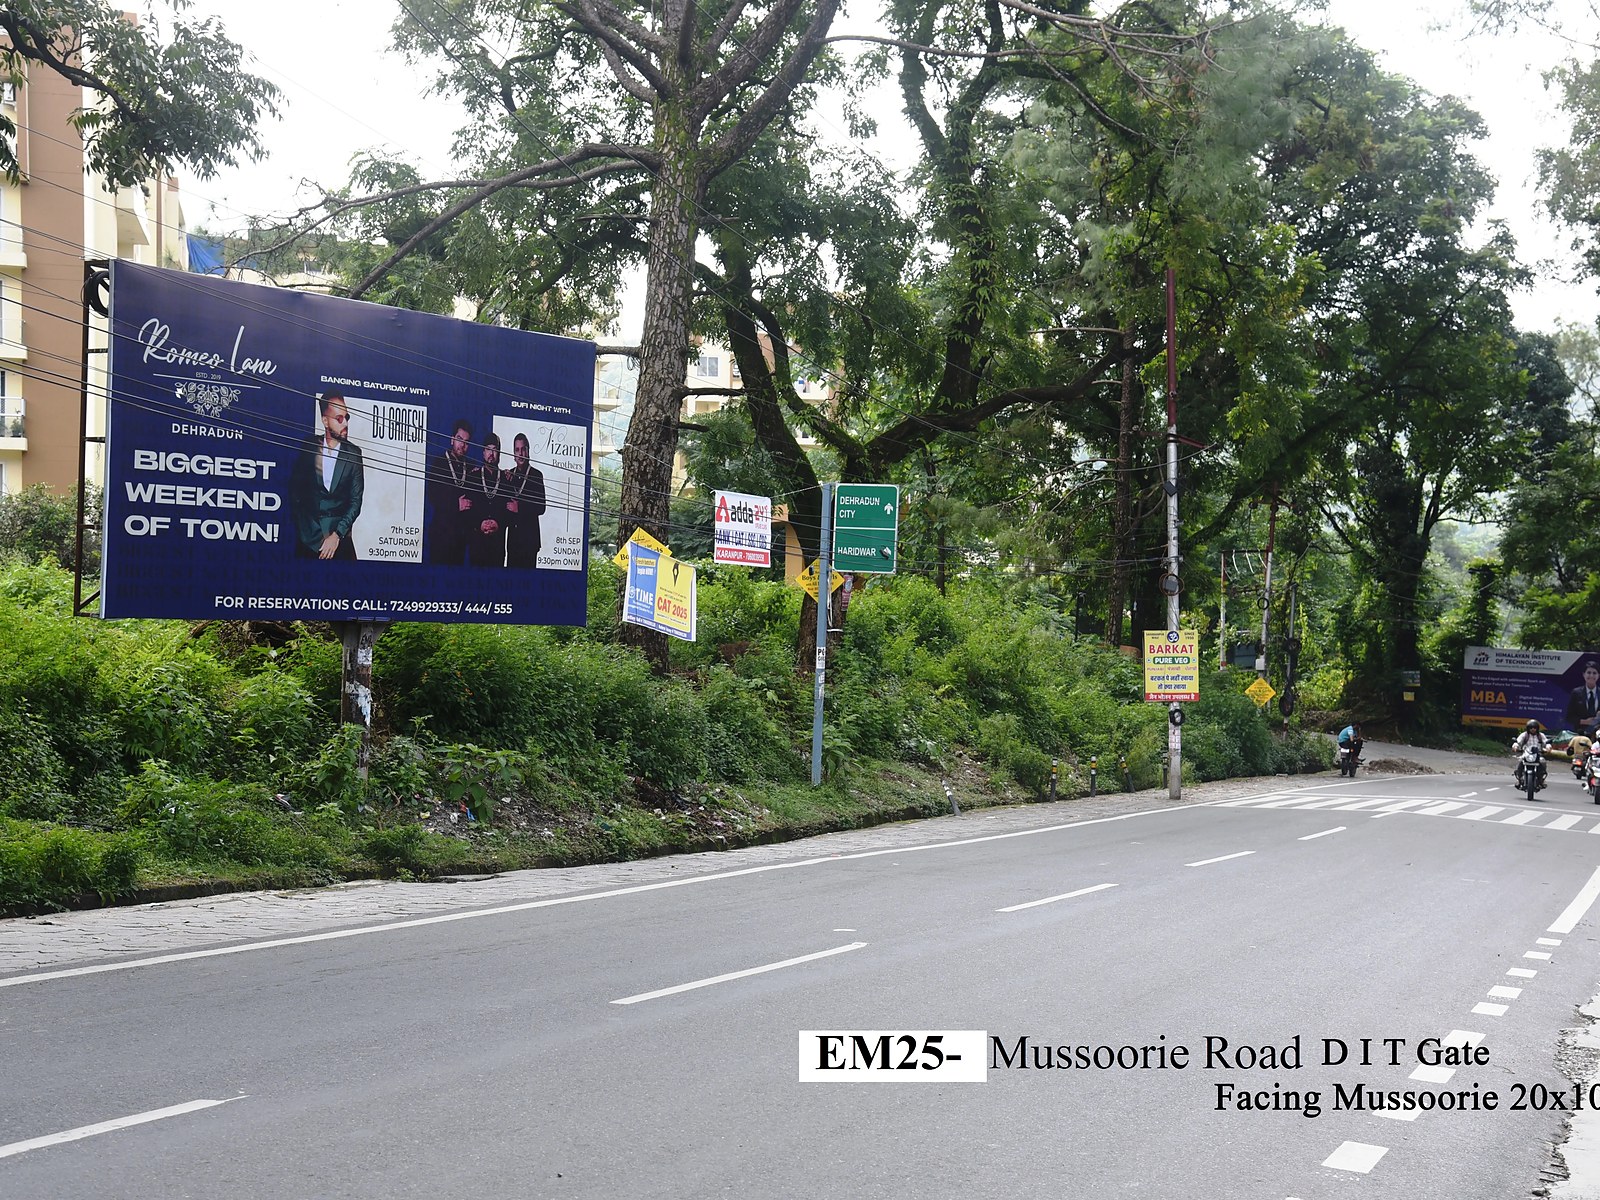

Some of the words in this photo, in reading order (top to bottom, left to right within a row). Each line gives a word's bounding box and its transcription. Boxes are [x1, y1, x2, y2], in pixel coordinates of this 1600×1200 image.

[138, 318, 224, 369] Romeo
[231, 325, 277, 376] Lane
[320, 375, 361, 387] BANGING
[363, 380, 408, 393] SATURDAY
[409, 387, 430, 396] WITH
[511, 401, 527, 409] SUFI
[529, 403, 552, 412] NIGHT
[553, 406, 571, 415] WITH
[372, 405, 385, 440] DJ
[172, 423, 243, 440] DEHRADUN
[134, 449, 276, 480] BIGGEST
[552, 458, 583, 471] Brothers
[125, 481, 282, 512] WEEKEND
[839, 496, 880, 506] DEHRADUN
[839, 509, 856, 519] CITY
[124, 514, 171, 536] OF
[180, 518, 280, 543] TOWN!
[391, 526, 404, 534] 7th
[405, 526, 420, 535] SEP
[378, 536, 420, 547] SATURDAY
[568, 537, 581, 545] SEP
[368, 548, 397, 558] 9:30pm
[398, 549, 419, 558] ONW
[553, 546, 580, 556] SUNDAY
[717, 549, 743, 560] KARANPUR
[837, 547, 877, 557] HARIDWAR
[537, 557, 562, 566] 9:30pm
[563, 558, 580, 567] ONW
[636, 588, 654, 607] TIME
[215, 596, 244, 609] FOR
[248, 597, 350, 611] RESERVATIONS
[352, 599, 388, 611] CALL:
[465, 602, 493, 615] 444/
[494, 603, 513, 615] 555
[657, 596, 672, 614] CAT
[672, 604, 688, 620] 2025
[1149, 644, 1194, 654] BARKAT
[1495, 652, 1530, 660] HIMALAYAN
[1470, 690, 1507, 704] MBA
